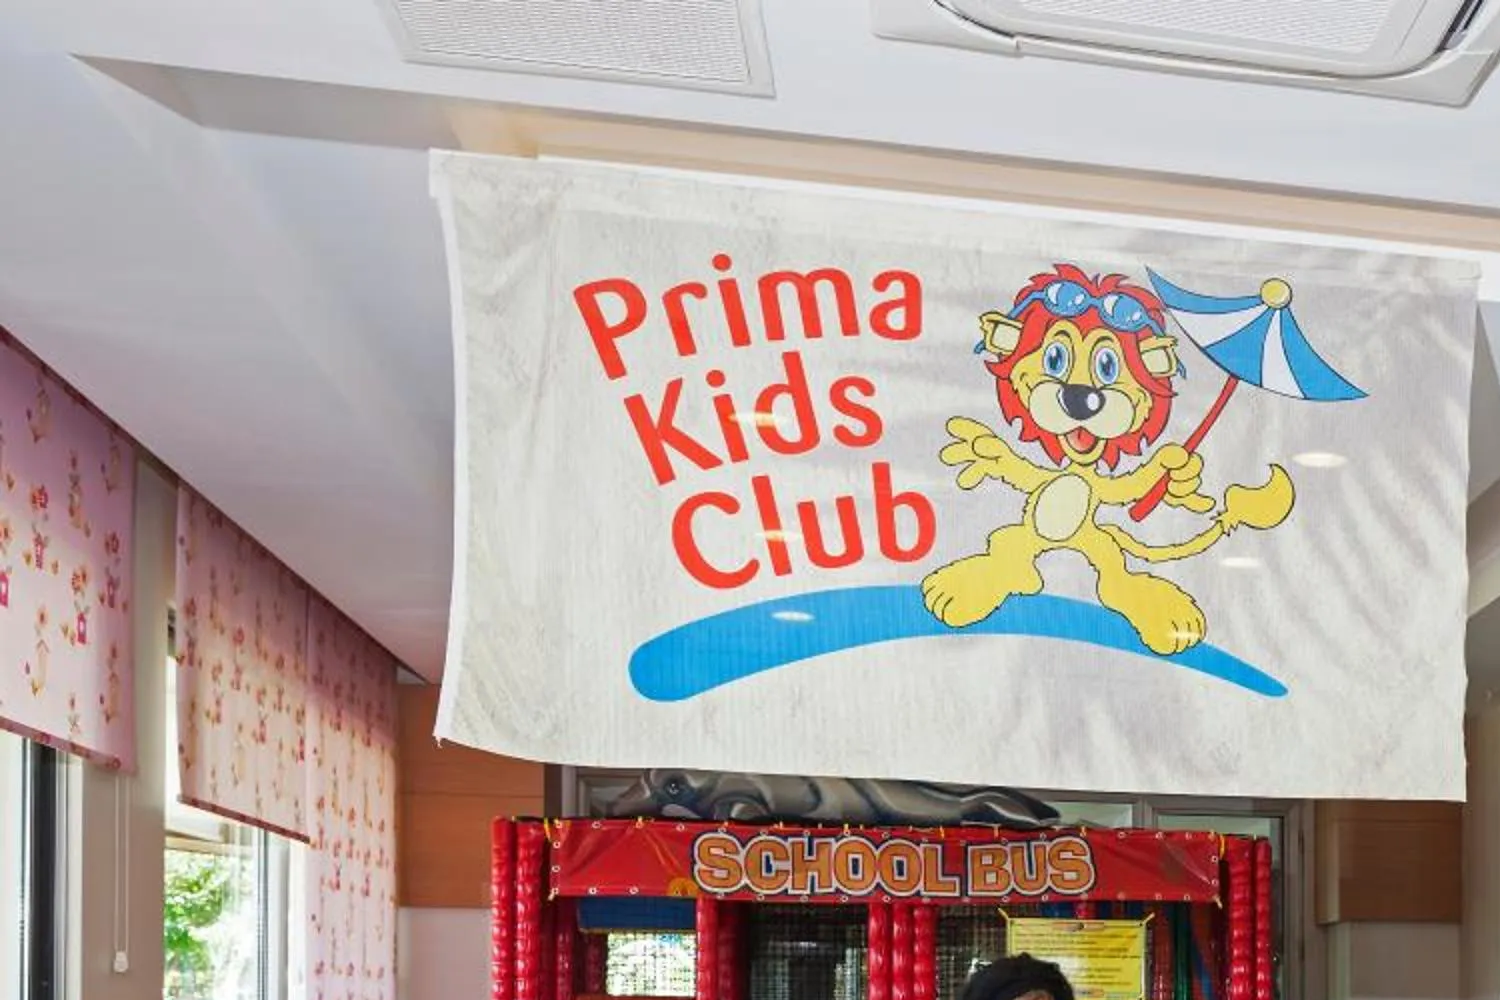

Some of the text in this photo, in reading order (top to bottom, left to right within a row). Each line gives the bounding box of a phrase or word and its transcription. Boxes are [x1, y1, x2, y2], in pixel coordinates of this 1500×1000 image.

[574, 254, 922, 379] Prima
[623, 352, 883, 485] Kids
[672, 463, 936, 589] Club
[694, 832, 1095, 897] SCHOOL BUS
